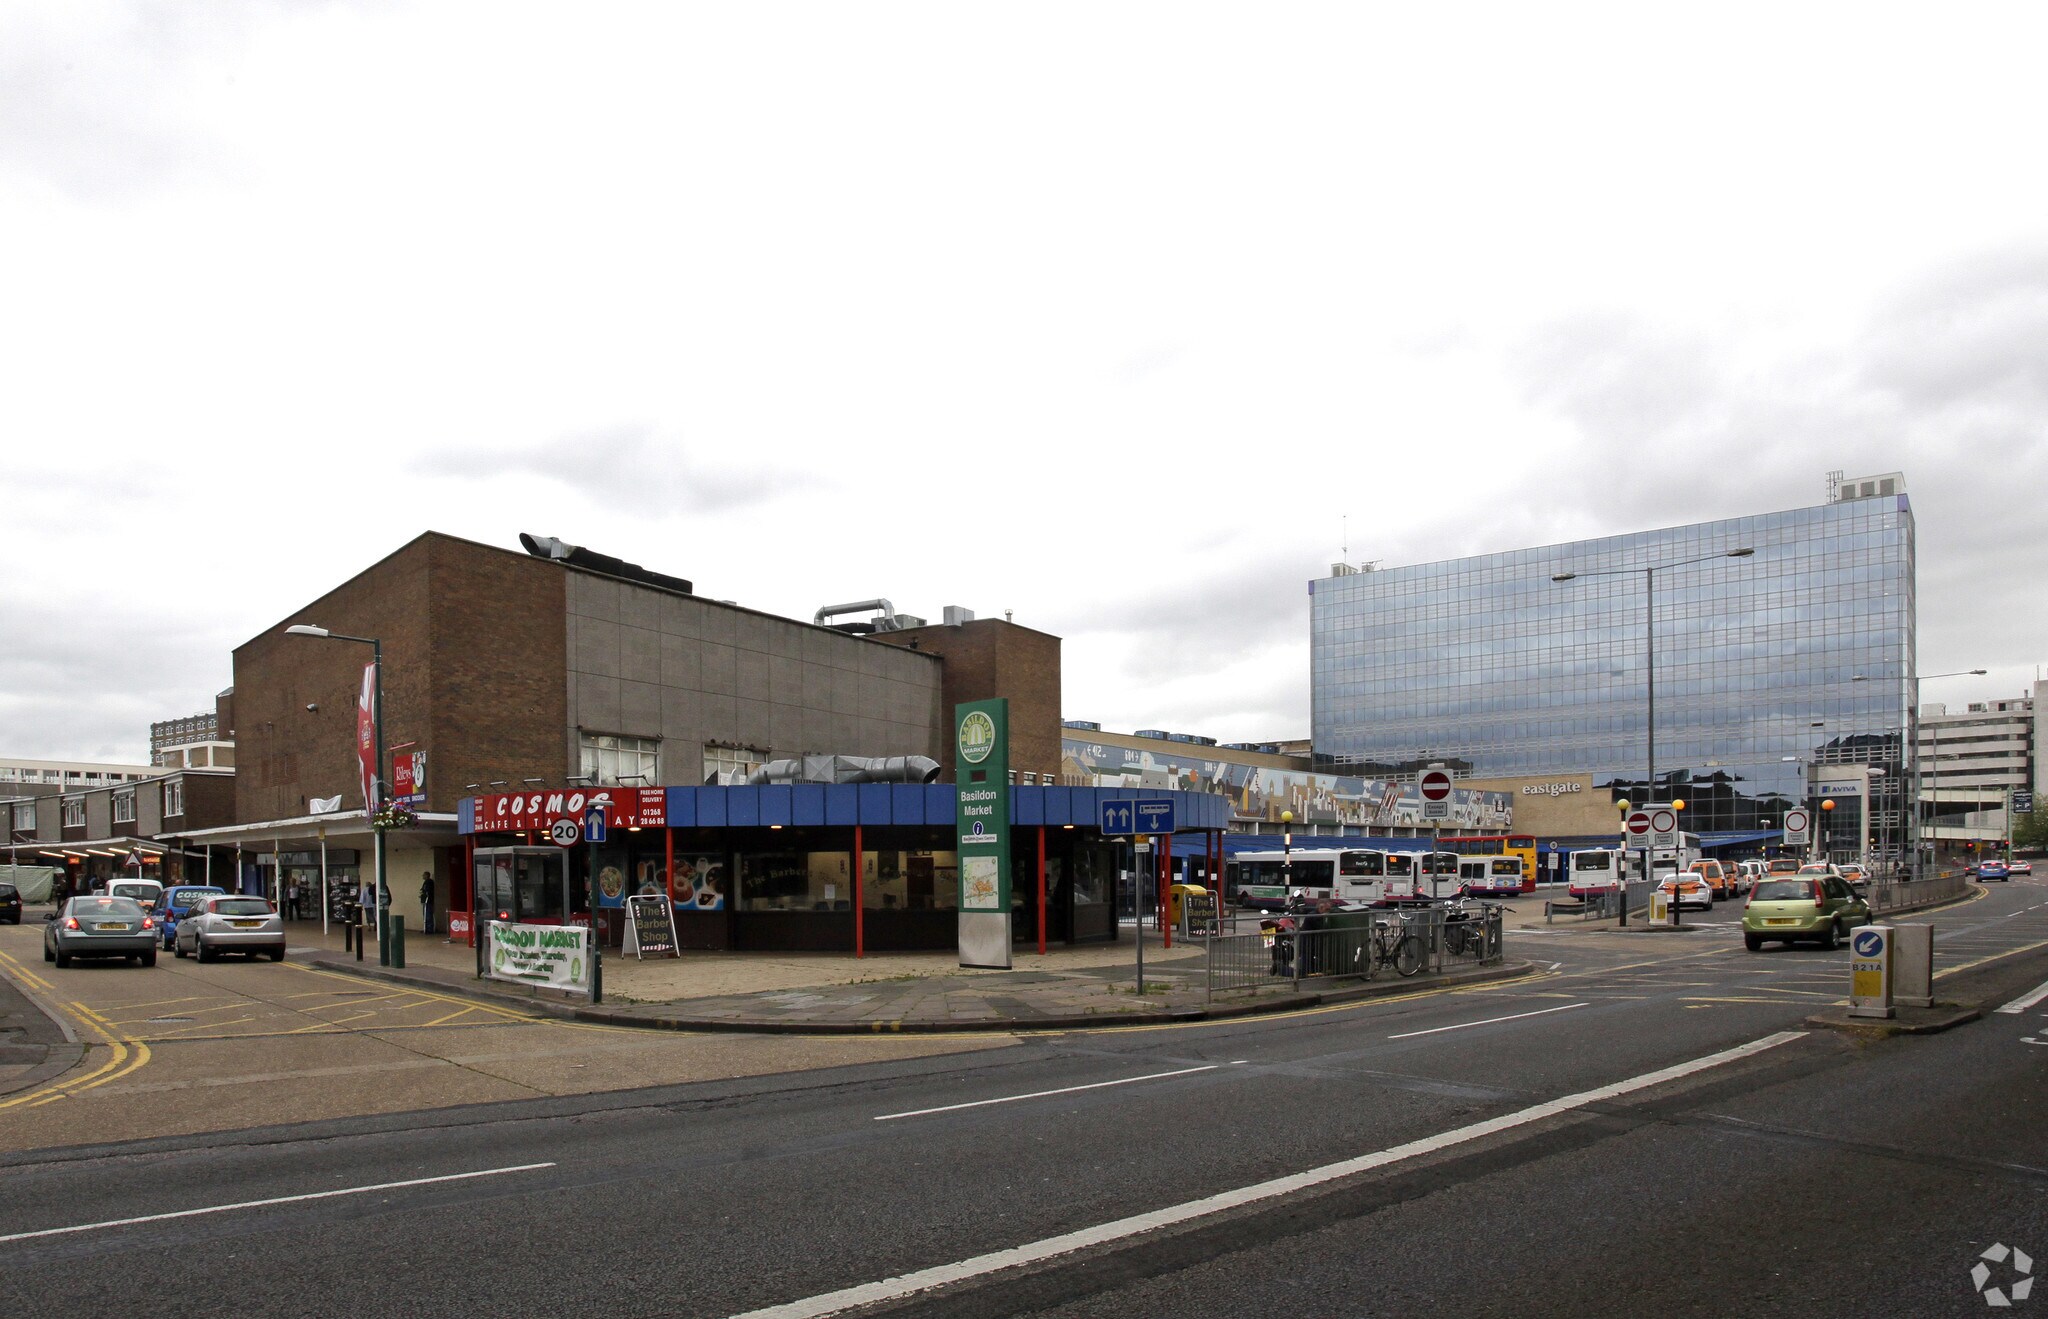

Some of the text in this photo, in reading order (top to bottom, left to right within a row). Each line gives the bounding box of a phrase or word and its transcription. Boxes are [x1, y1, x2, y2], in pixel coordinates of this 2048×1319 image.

[961, 714, 991, 742] BASILDON
[963, 746, 988, 754] MARKET
[396, 766, 411, 781] Rileys
[1522, 781, 1581, 797] eastgate
[1832, 785, 1857, 793] AVIVA
[960, 790, 997, 802] Basildon
[642, 808, 661, 816] 01268
[964, 804, 993, 816] Market
[484, 820, 508, 830] CAFE
[516, 819, 522, 828] &
[553, 825, 577, 839] 20
[746, 875, 766, 888] The
[1194, 898, 1209, 907] The
[641, 906, 660, 916] The
[1187, 908, 1216, 917] Barber
[636, 919, 669, 929] Barber
[539, 930, 581, 949] MARKET
[642, 931, 668, 942] Shop
